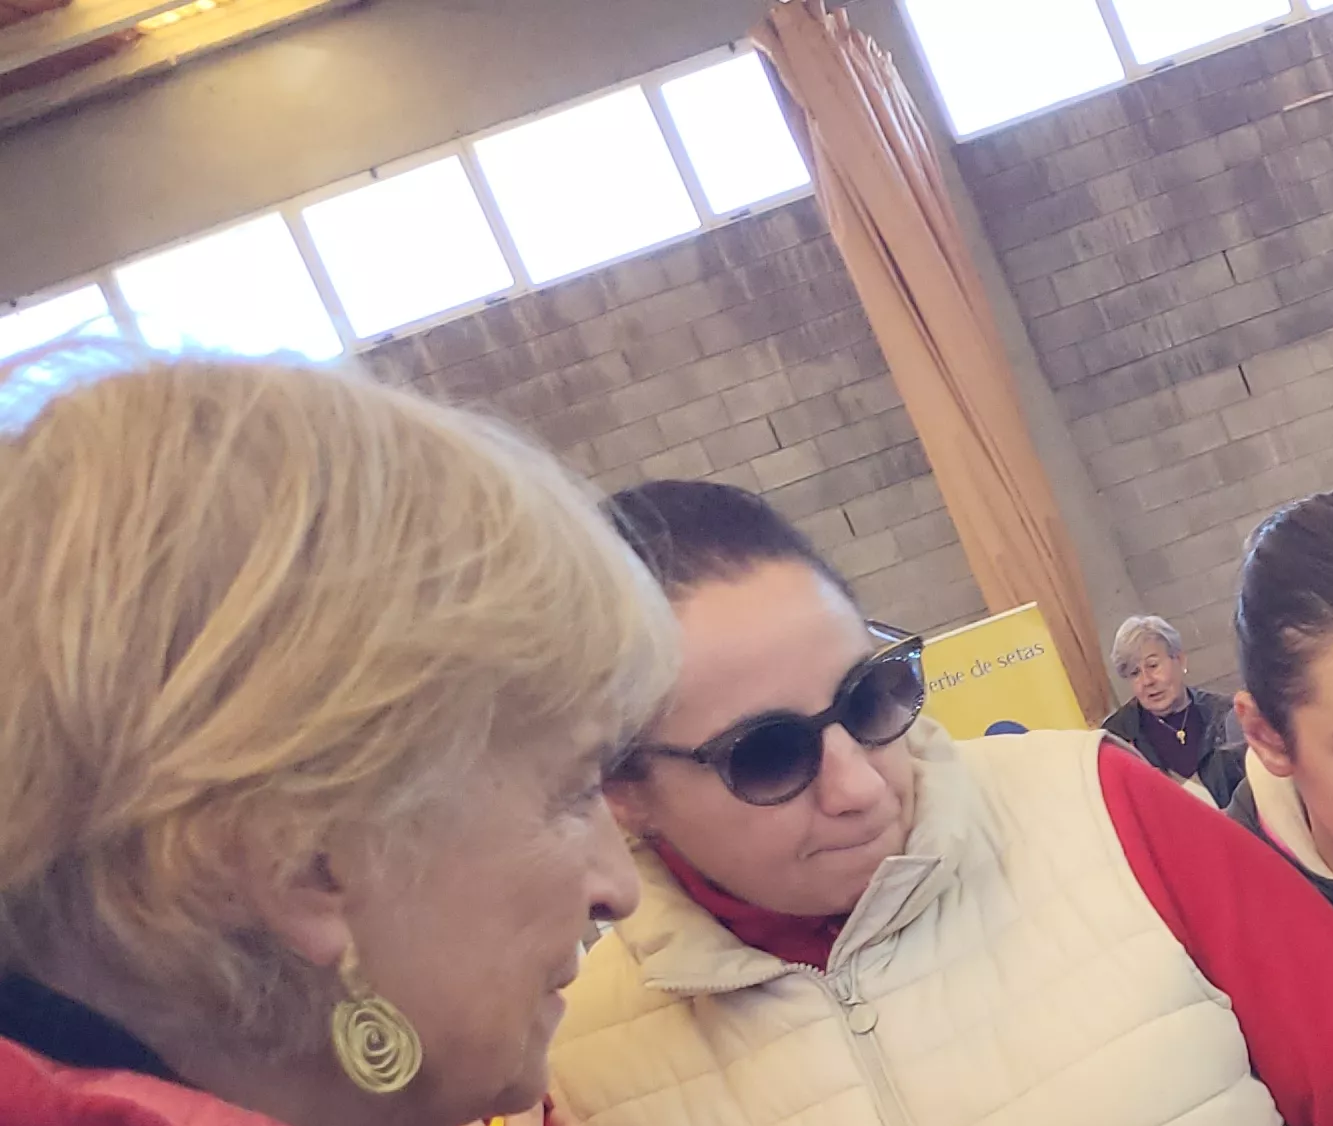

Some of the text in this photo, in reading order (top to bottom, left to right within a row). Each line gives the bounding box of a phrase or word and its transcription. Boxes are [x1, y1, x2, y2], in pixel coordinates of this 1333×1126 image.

[926, 643, 1045, 693] erbe de setas
